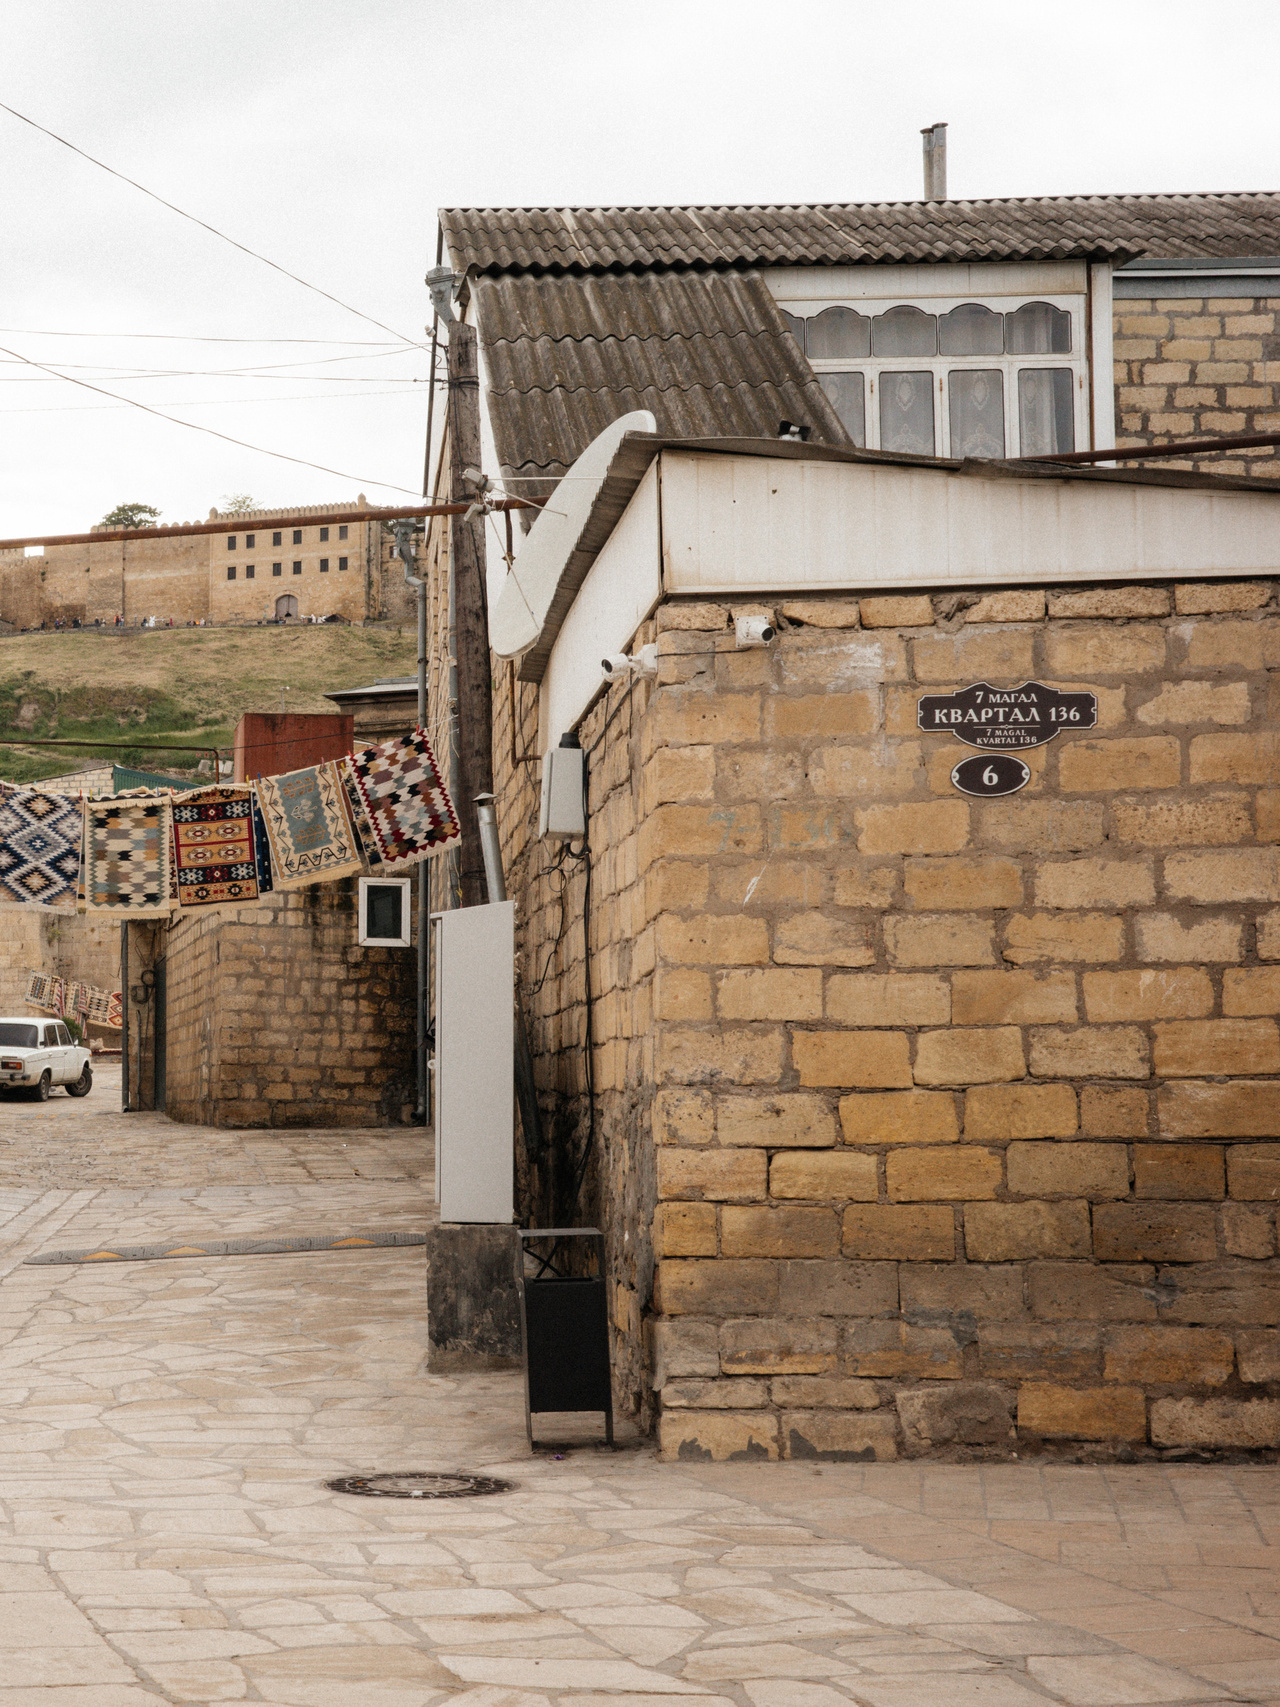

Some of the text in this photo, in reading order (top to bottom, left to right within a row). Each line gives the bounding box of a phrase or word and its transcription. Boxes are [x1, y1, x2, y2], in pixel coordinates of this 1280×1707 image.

[975, 691, 1038, 703] 7 МАГАЛ
[934, 706, 1081, 723] КВАРТАЛ 136
[986, 728, 992, 736] 7
[976, 736, 1037, 745] KVARTAL 136
[982, 764, 999, 786] 6
